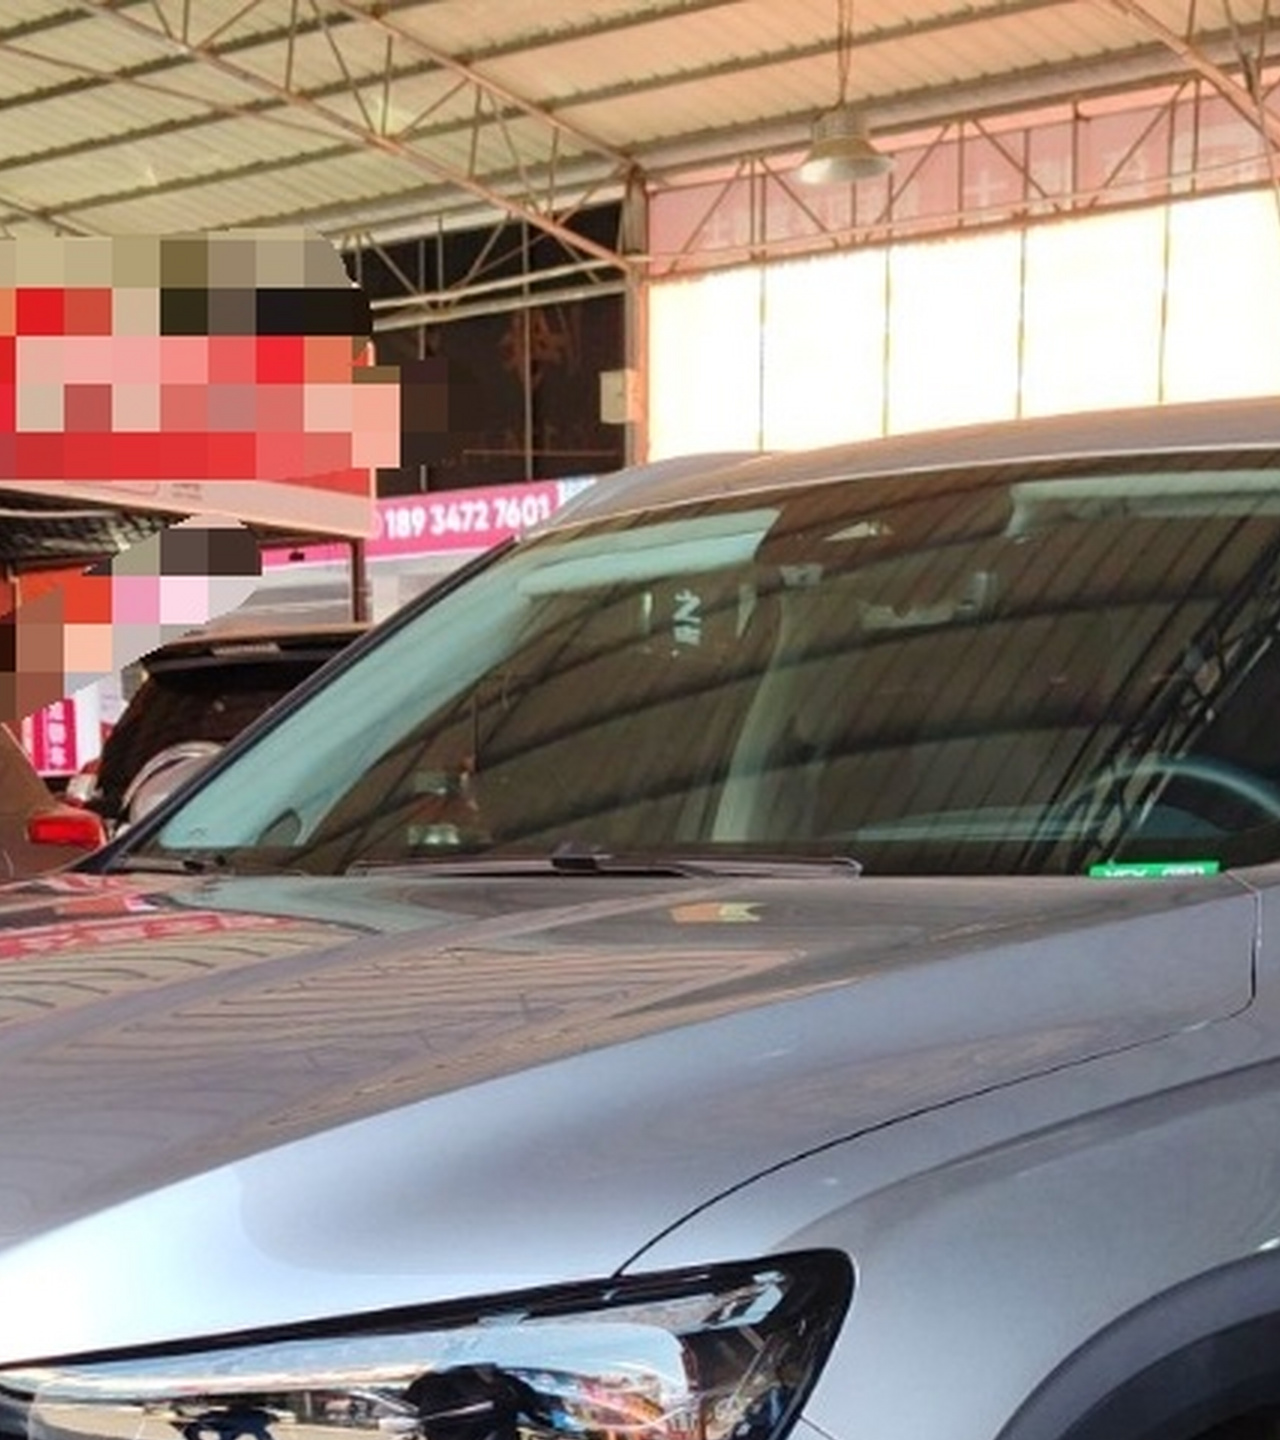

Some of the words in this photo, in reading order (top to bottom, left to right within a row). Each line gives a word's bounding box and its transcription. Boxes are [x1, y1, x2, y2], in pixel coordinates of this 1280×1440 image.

[384, 506, 427, 540] 189
[429, 499, 490, 535] 3472
[493, 492, 551, 529] 7601
